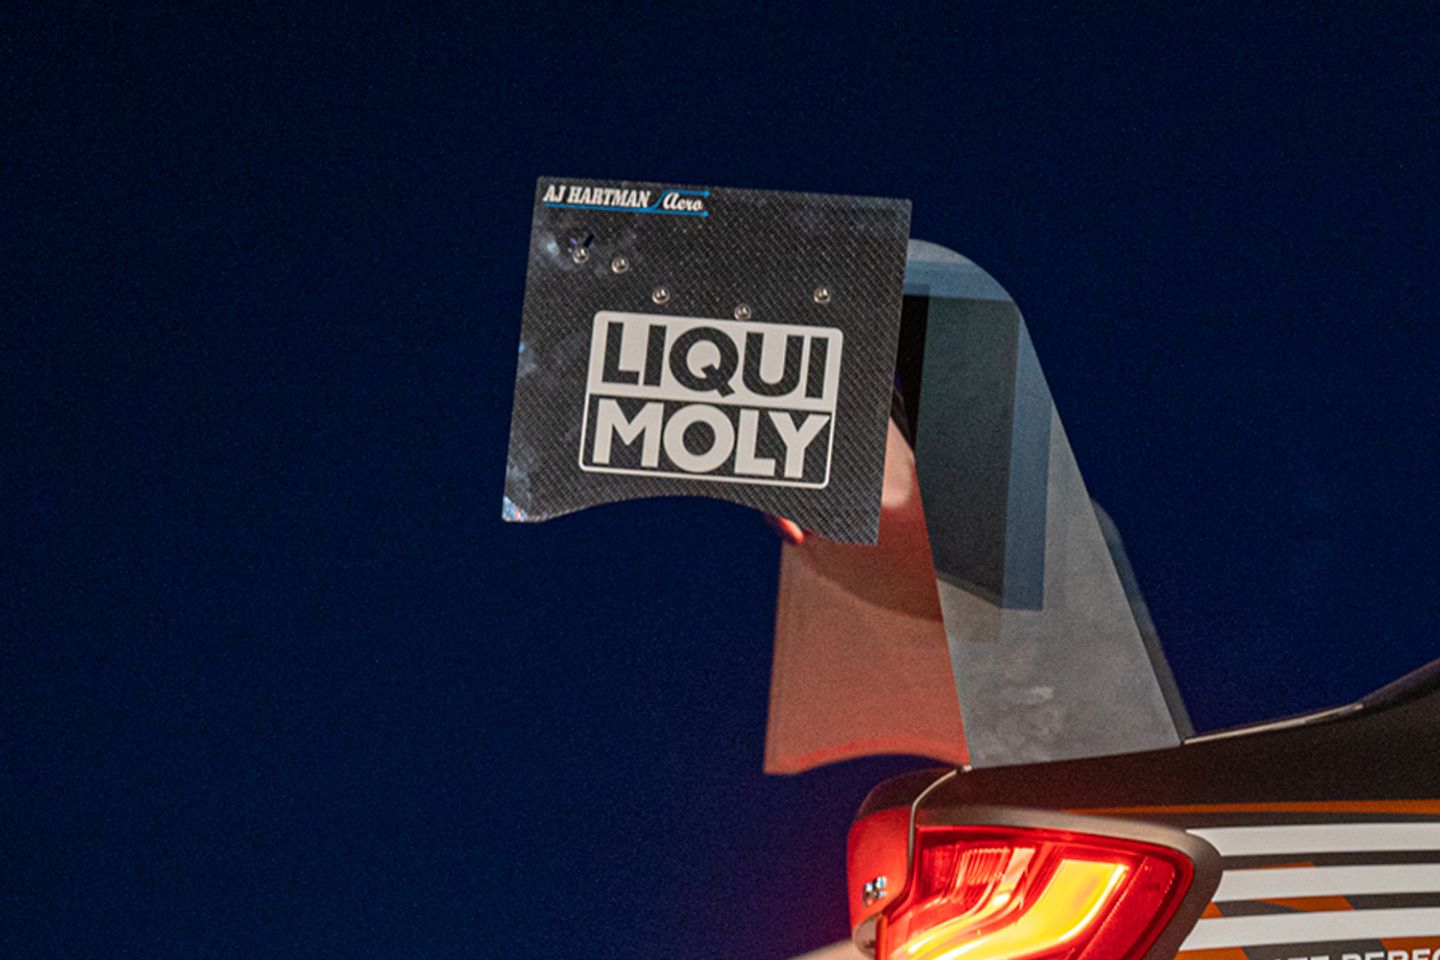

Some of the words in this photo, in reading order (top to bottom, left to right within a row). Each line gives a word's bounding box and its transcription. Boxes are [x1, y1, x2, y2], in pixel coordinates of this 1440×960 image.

[543, 184, 567, 203] AJ
[567, 185, 651, 209] HARTMAN
[601, 320, 830, 400] LIQUI
[592, 399, 831, 480] MOLY
